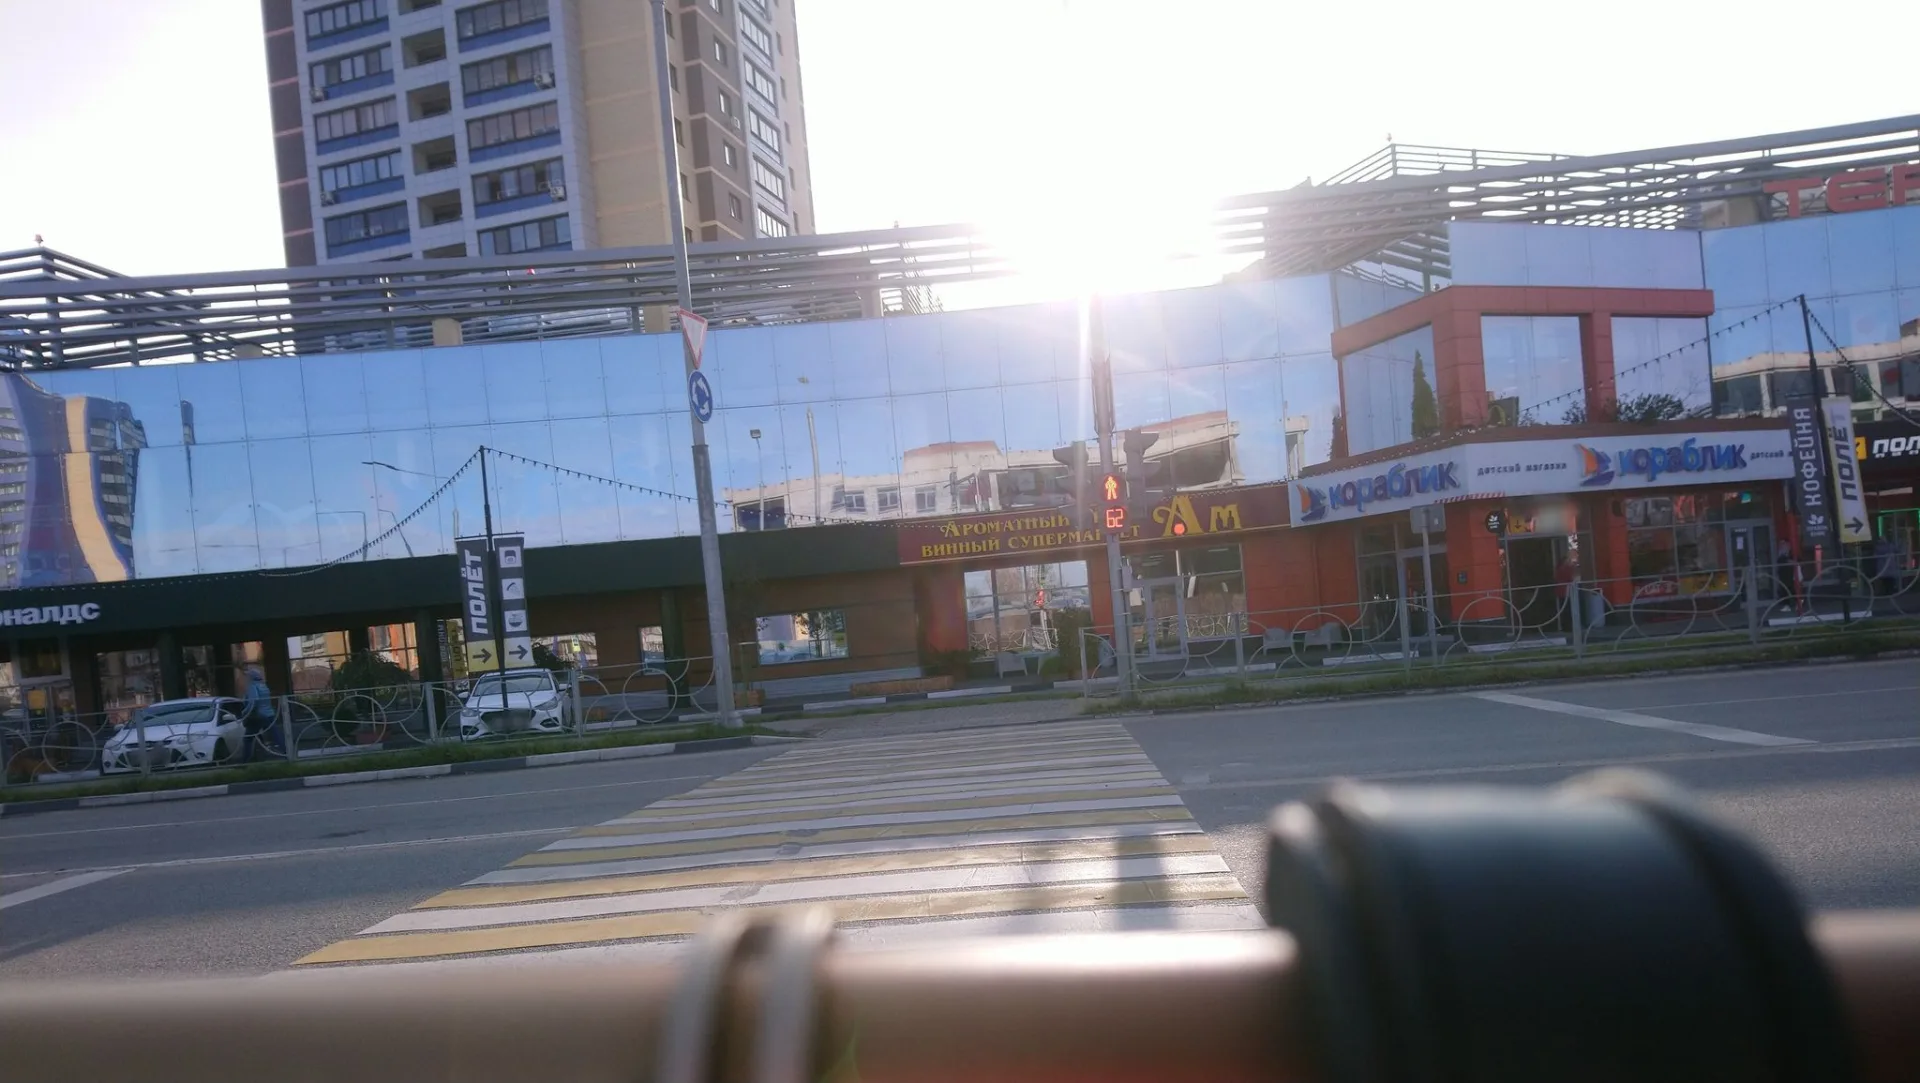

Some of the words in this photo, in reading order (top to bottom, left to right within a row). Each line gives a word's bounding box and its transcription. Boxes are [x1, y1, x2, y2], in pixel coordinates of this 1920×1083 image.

[1477, 463, 1521, 477] детский
[1526, 462, 1568, 472] магазин
[1618, 437, 1747, 482] кораблик
[1793, 408, 1822, 506] КОФЕЙНЯ
[1828, 407, 1859, 500] ПОЛЁТ
[1329, 461, 1460, 512] кораблик
[1106, 508, 1124, 528] 62
[921, 536, 1001, 559] ВИННЫЙ
[1008, 525, 1141, 550] СУПЕРМАТ
[0, 602, 101, 625] налдс
[461, 549, 488, 635] ПОЛЁТ
